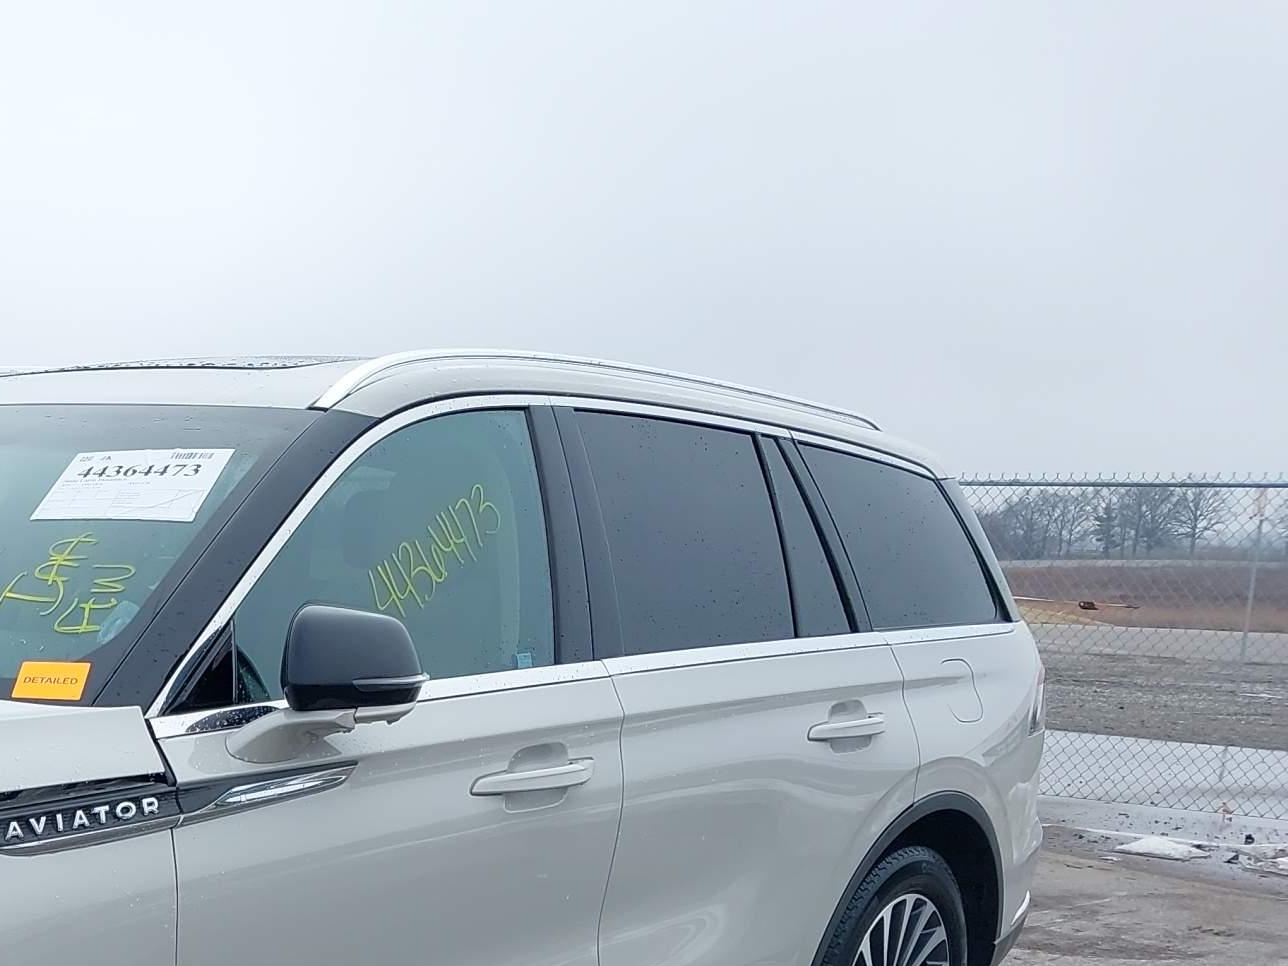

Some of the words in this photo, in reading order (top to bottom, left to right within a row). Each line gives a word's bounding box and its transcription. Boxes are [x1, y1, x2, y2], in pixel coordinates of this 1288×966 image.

[77, 464, 202, 478] 44364473
[368, 484, 501, 617] 44364473
[23, 676, 79, 686] DETAILED
[4, 797, 160, 841] AVIATOR
